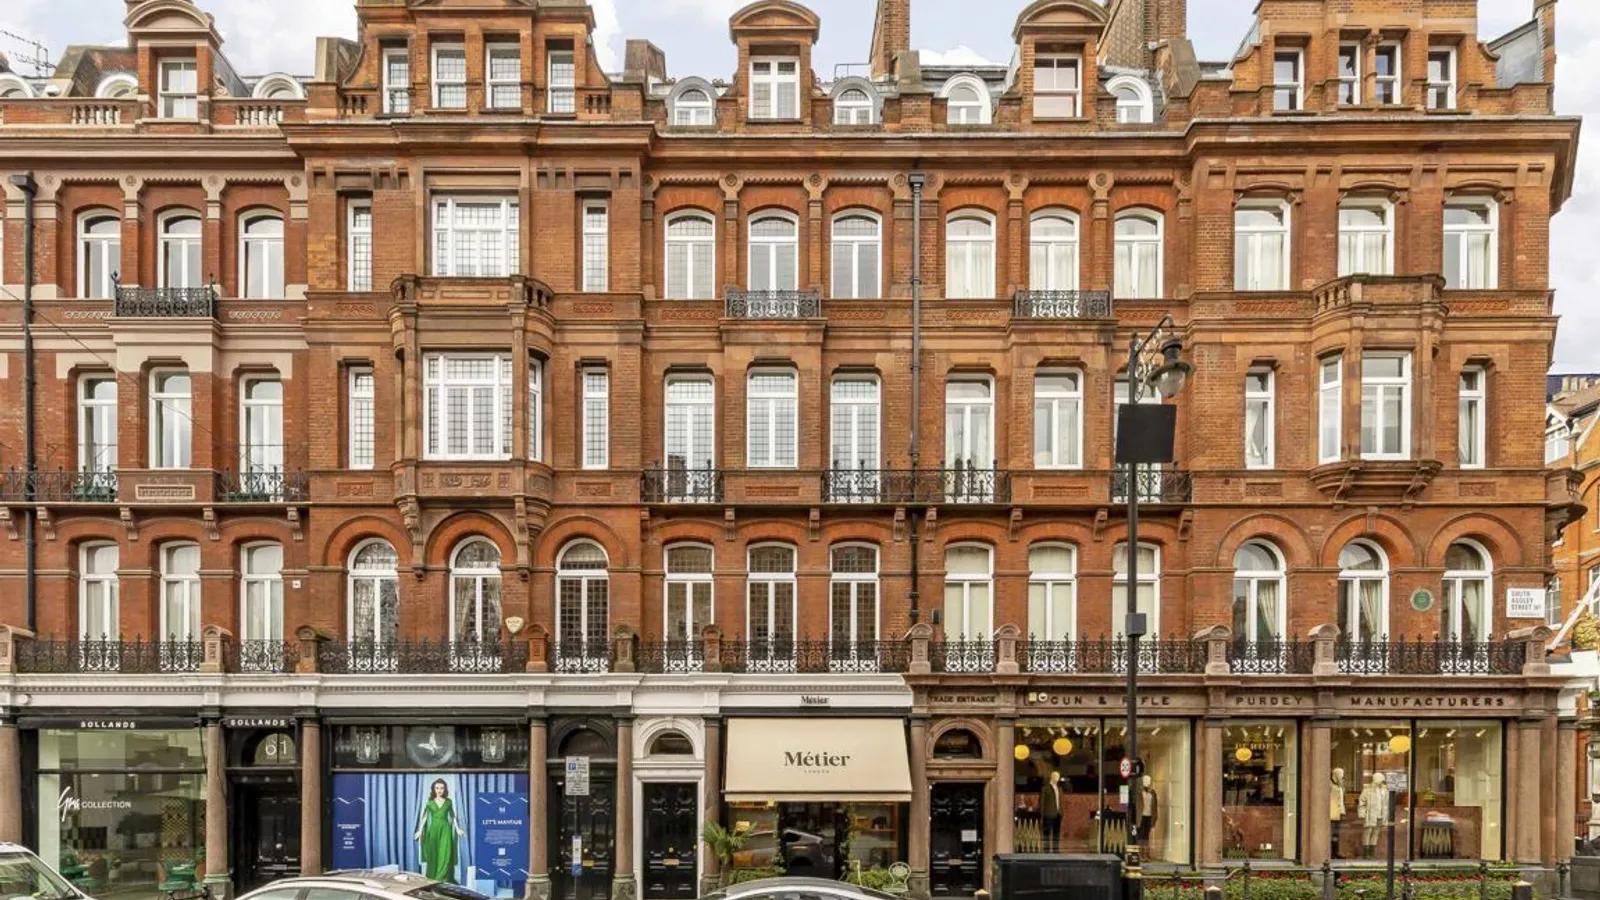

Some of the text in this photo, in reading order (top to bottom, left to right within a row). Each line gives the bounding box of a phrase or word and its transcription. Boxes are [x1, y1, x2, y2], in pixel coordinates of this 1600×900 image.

[1050, 696, 1082, 705] GUN
[1098, 696, 1107, 705] &
[1236, 696, 1303, 705] PURDEY
[1351, 697, 1505, 706] MANUFACTURERS
[80, 721, 136, 729] SOLLANDS
[265, 740, 287, 756] 61
[784, 751, 851, 767] Métier
[82, 801, 132, 809] COLLECTION
